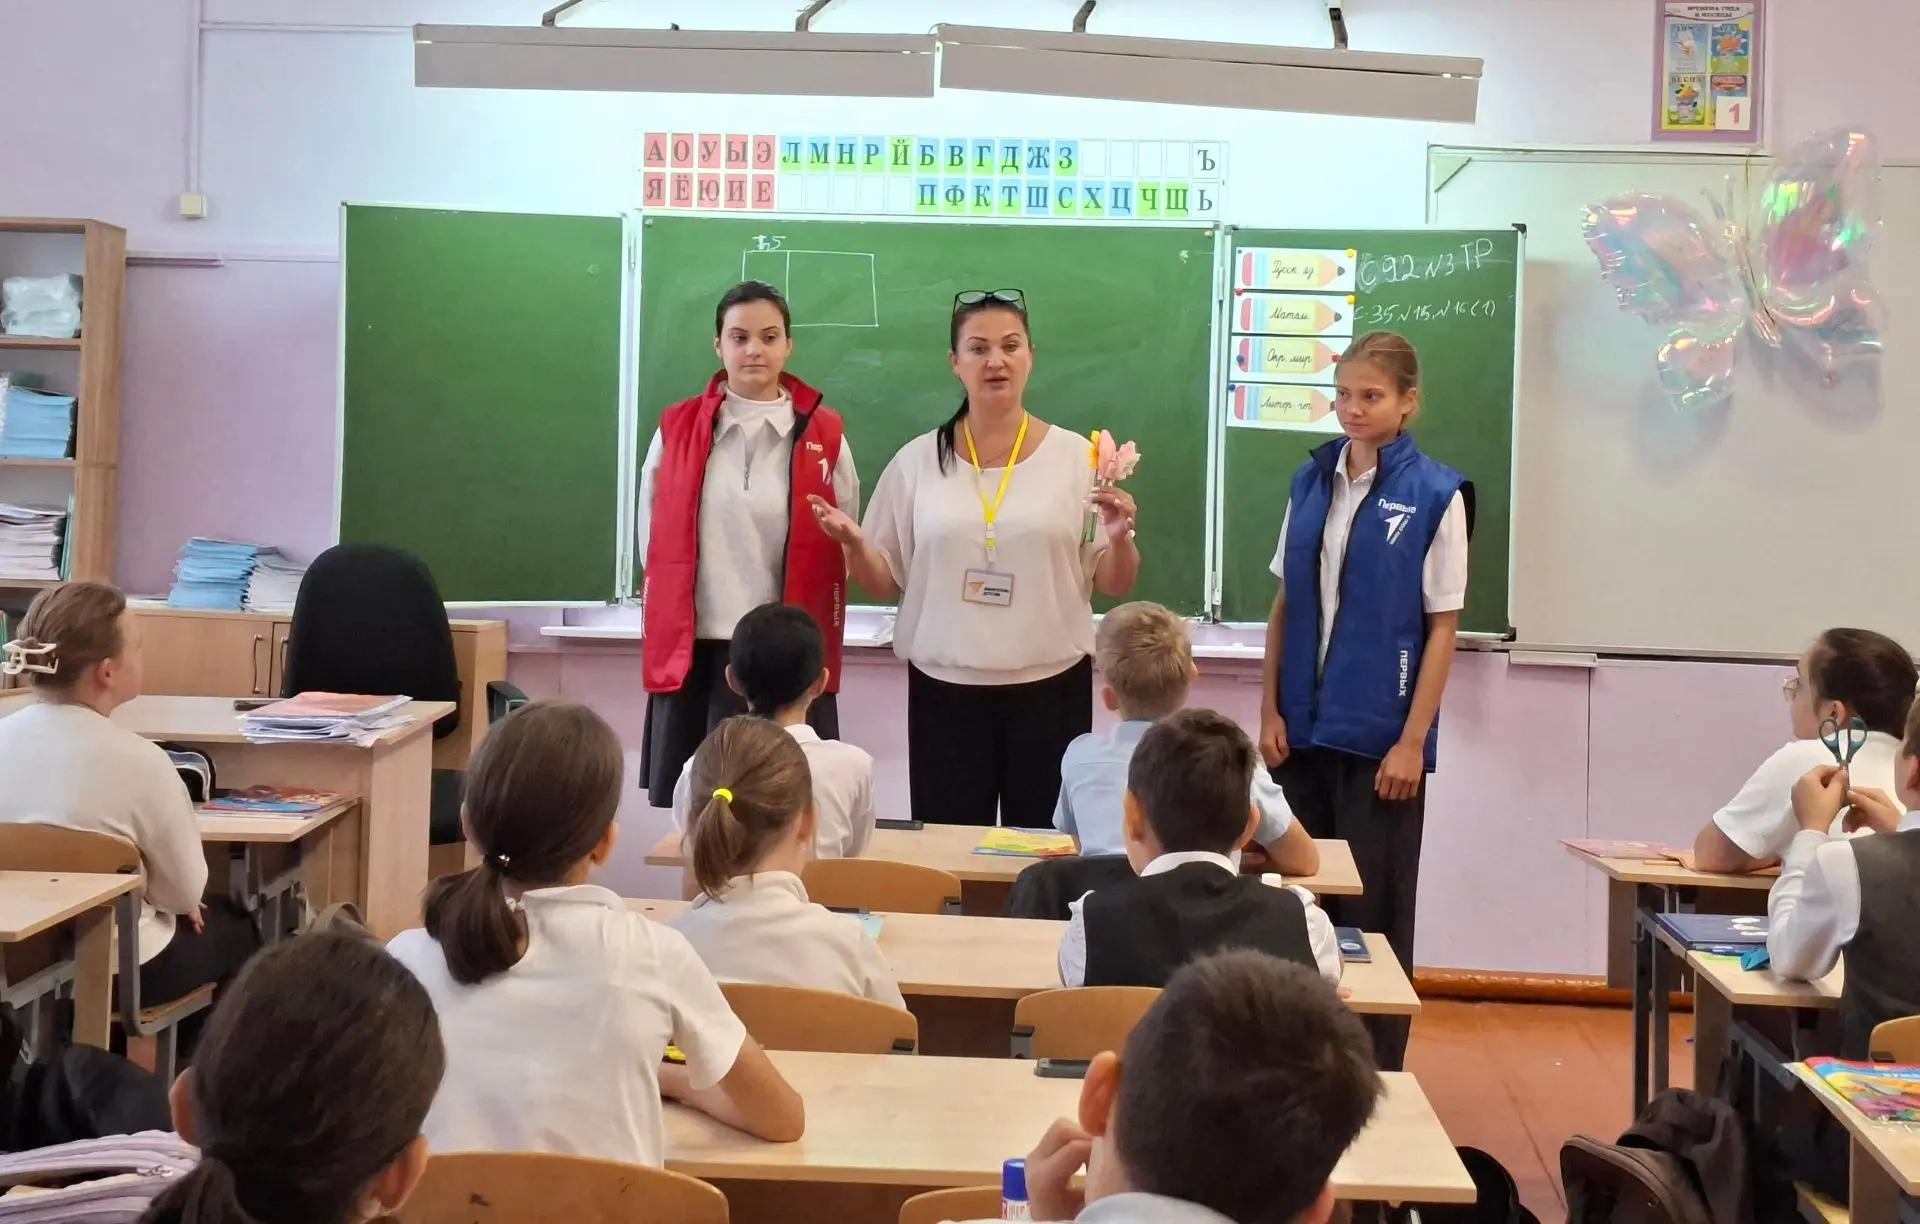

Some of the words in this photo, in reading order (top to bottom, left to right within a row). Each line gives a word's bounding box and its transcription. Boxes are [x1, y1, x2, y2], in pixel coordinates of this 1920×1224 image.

[1729, 103, 1741, 124] 1
[647, 140, 664, 161] А
[674, 140, 690, 162] О
[701, 141, 717, 163] У
[726, 141, 748, 163] Ы
[757, 141, 772, 163] Э
[782, 142, 801, 163] Л
[810, 142, 829, 164] М
[837, 143, 855, 165] Н
[864, 143, 880, 165] Р
[892, 138, 910, 166] Й
[919, 144, 935, 166] Б
[948, 145, 964, 167] В
[976, 145, 991, 167] Г
[1001, 146, 1019, 174] Д
[1027, 146, 1050, 168] Ж
[1059, 146, 1073, 169] З
[1197, 149, 1216, 171] Ъ
[646, 178, 664, 200] Я
[674, 174, 690, 201] Ё
[697, 179, 720, 202] Ю
[727, 180, 745, 202] И
[755, 180, 771, 203] Е
[918, 184, 936, 206] П
[945, 184, 965, 206] Ф
[974, 185, 991, 207] К
[1002, 185, 1018, 208] Т
[1026, 186, 1049, 208] Ш
[1058, 186, 1073, 209] С
[1084, 187, 1102, 209] Х
[1111, 187, 1131, 214] Ц
[1140, 188, 1158, 210] Ч
[1165, 188, 1189, 215] Щ
[1197, 189, 1213, 211] Ь
[1382, 254, 1420, 283] 92
[806, 441, 824, 453] Пер
[1378, 498, 1417, 514] Первые
[1399, 650, 1408, 697] ПЕРВЫХ
